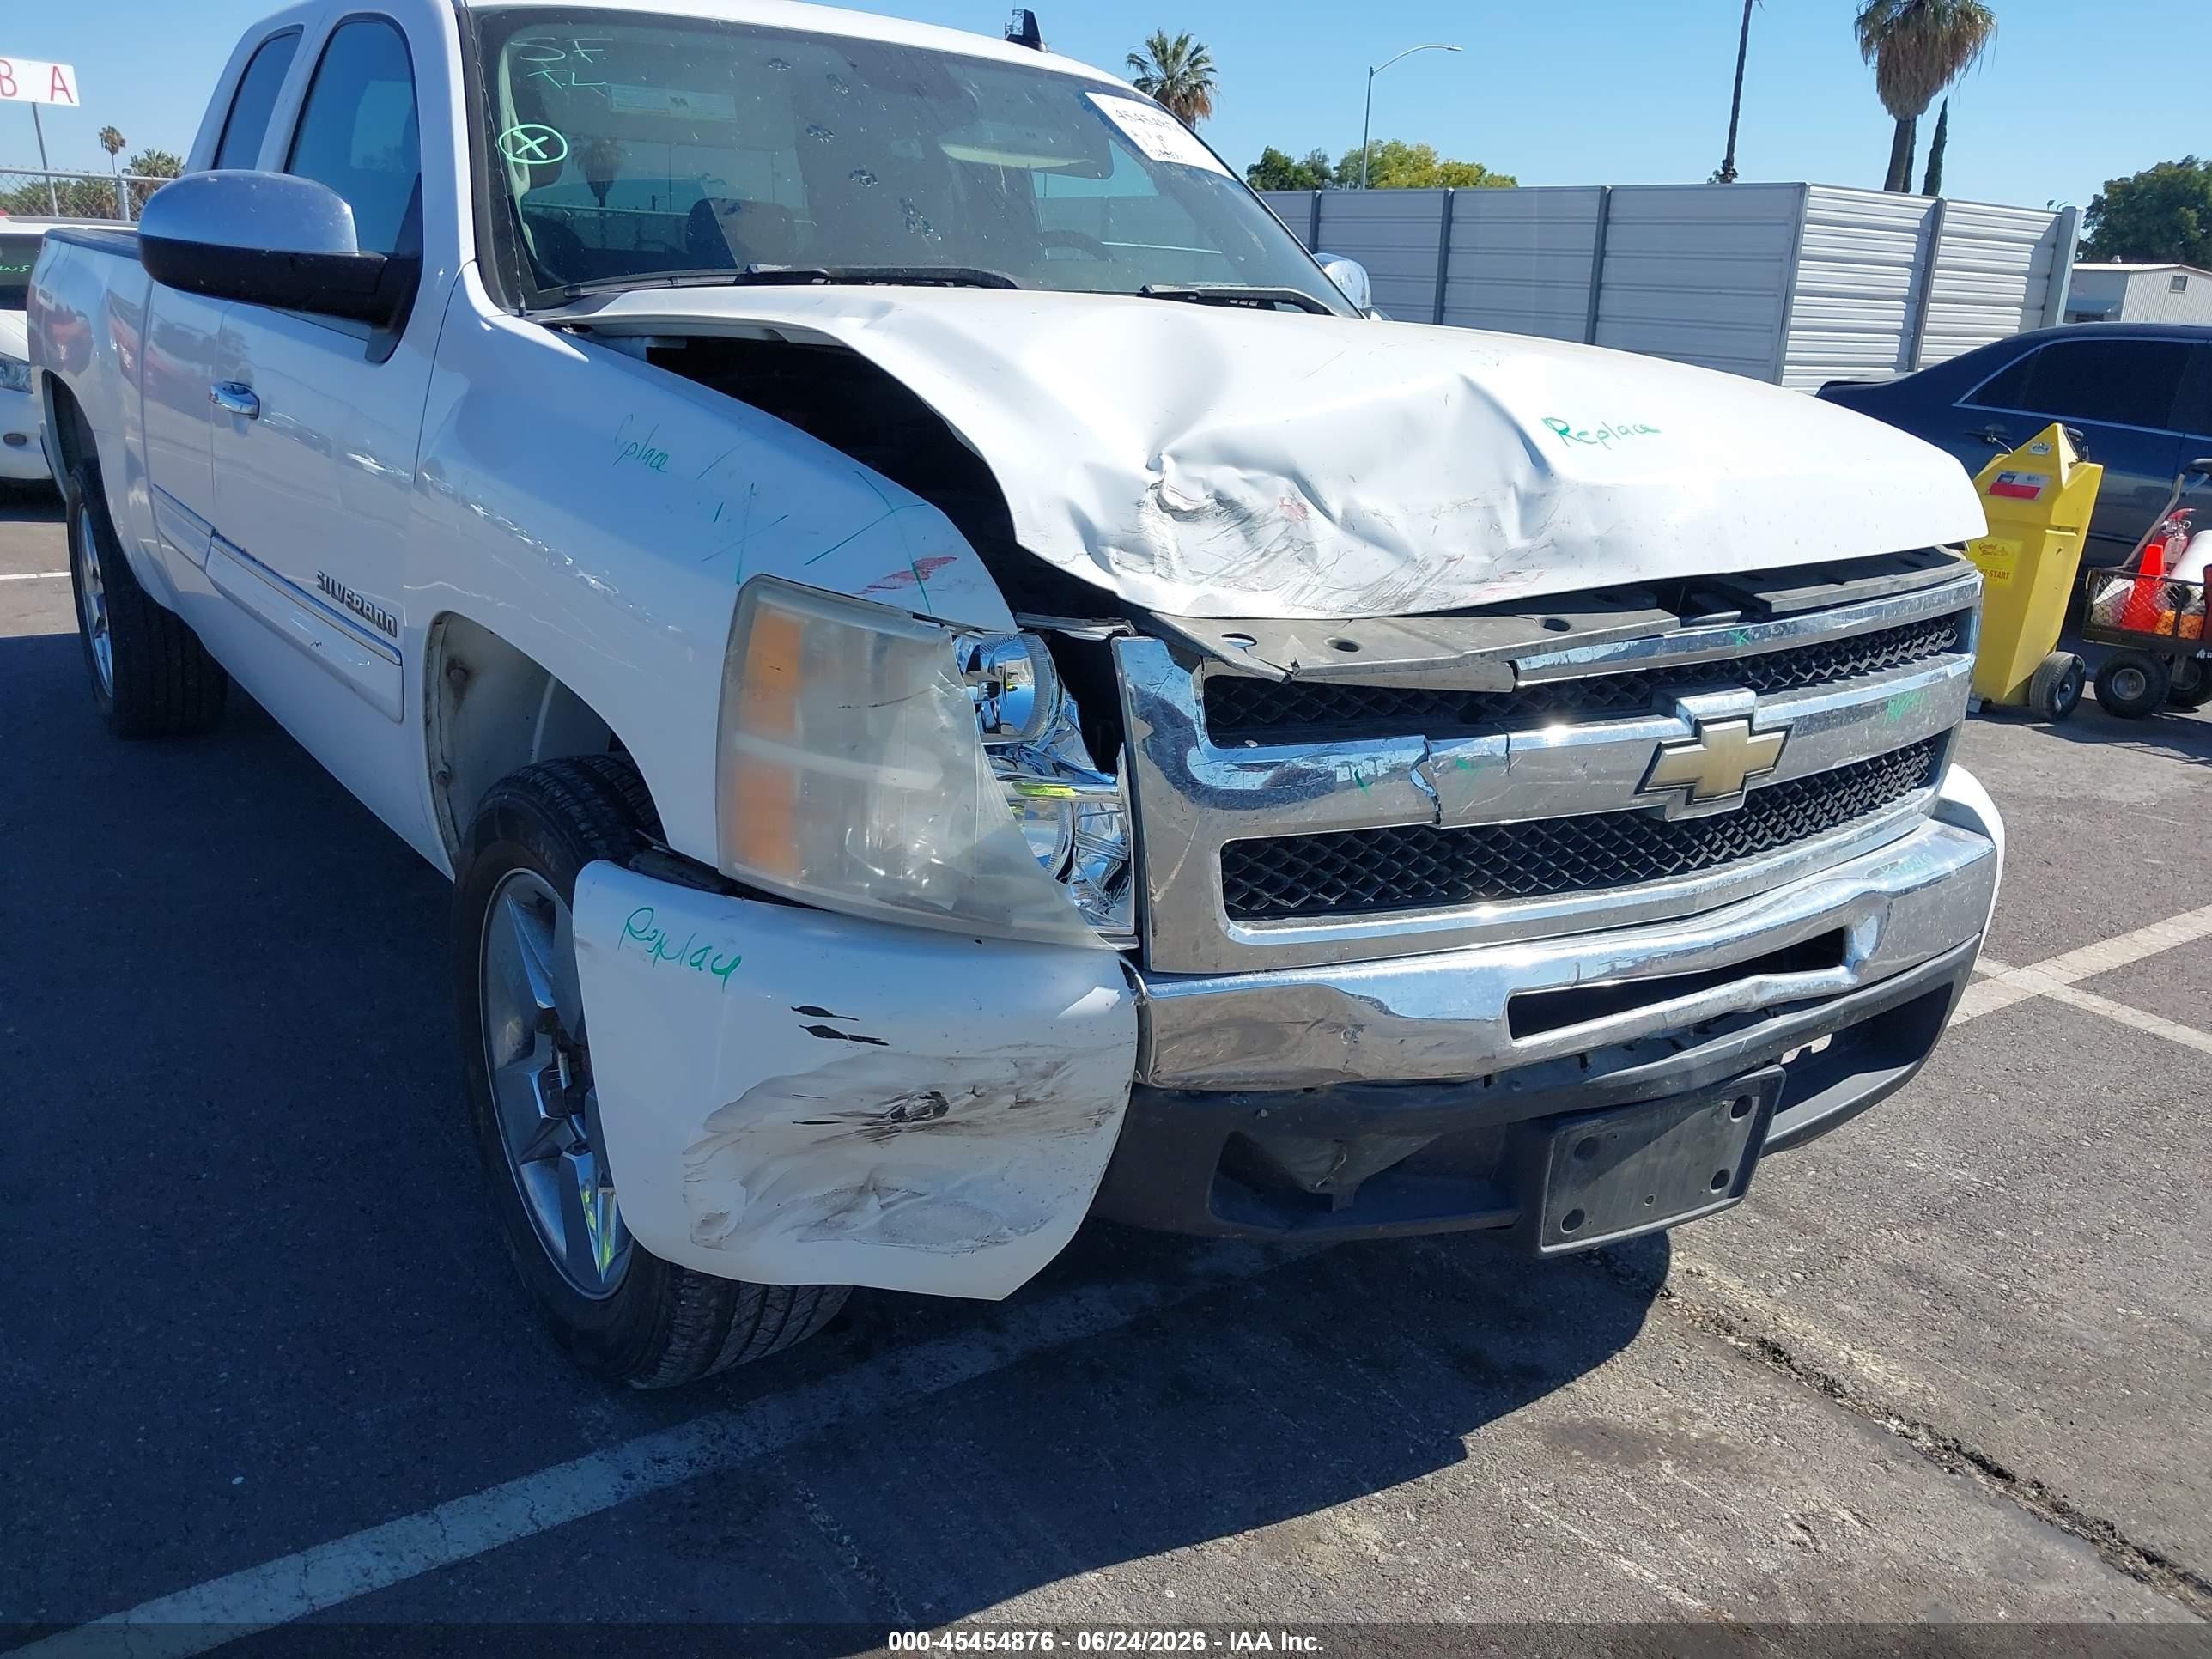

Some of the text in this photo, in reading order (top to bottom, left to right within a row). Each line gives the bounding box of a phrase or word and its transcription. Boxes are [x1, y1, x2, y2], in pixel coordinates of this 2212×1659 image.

[0, 59, 74, 104] B A
[316, 570, 398, 638] SILVERADO
